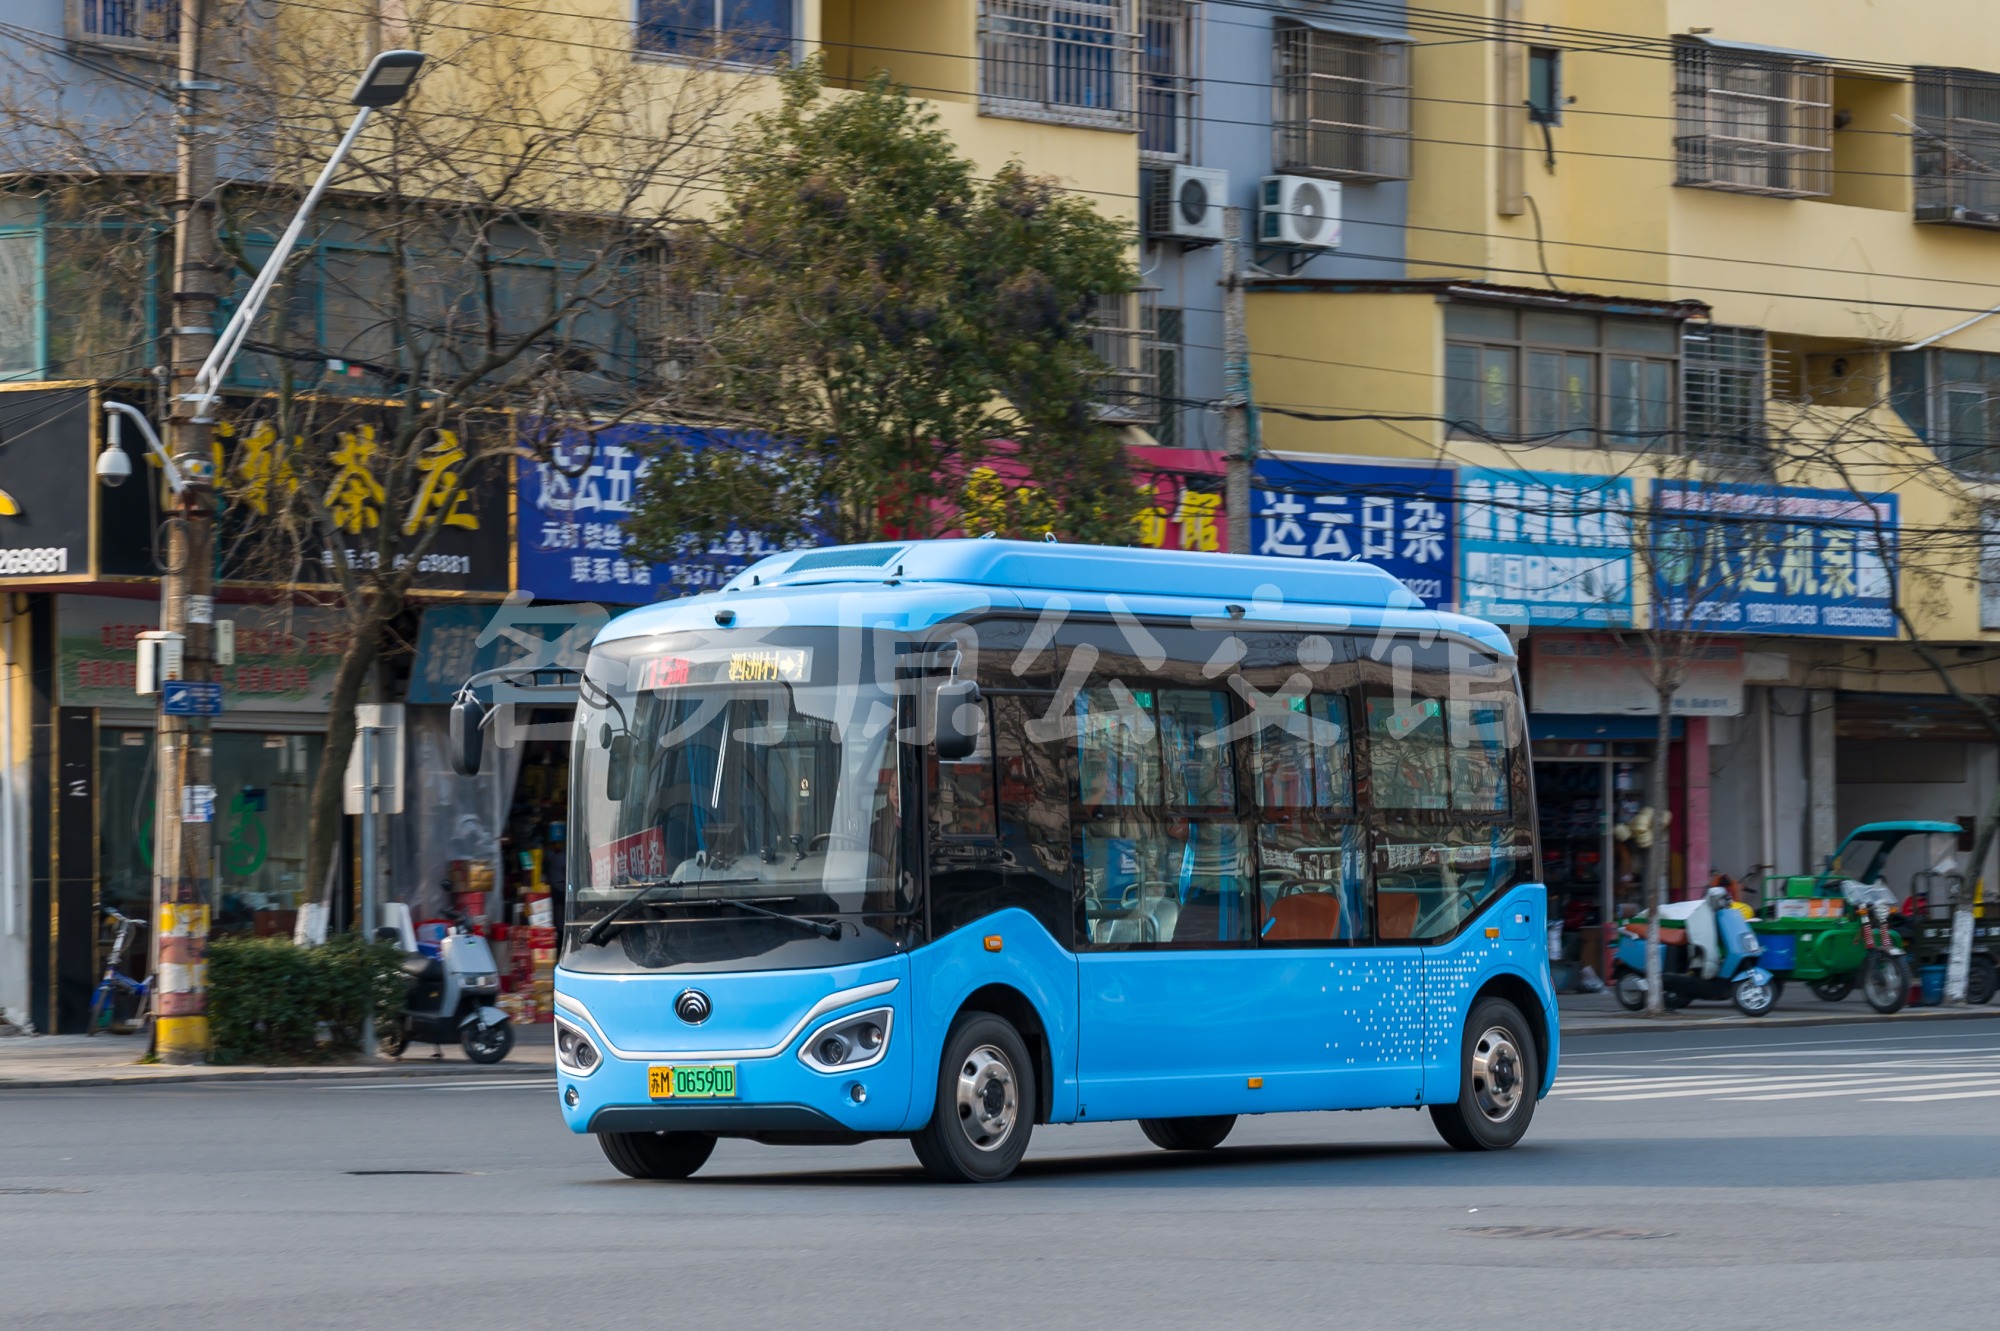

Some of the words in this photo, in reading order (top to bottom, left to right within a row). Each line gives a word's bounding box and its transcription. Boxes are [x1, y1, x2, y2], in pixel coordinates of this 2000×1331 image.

[1260, 486, 1446, 563] 达云日杂
[570, 556, 651, 585] 联系电话
[649, 656, 690, 689] 15路
